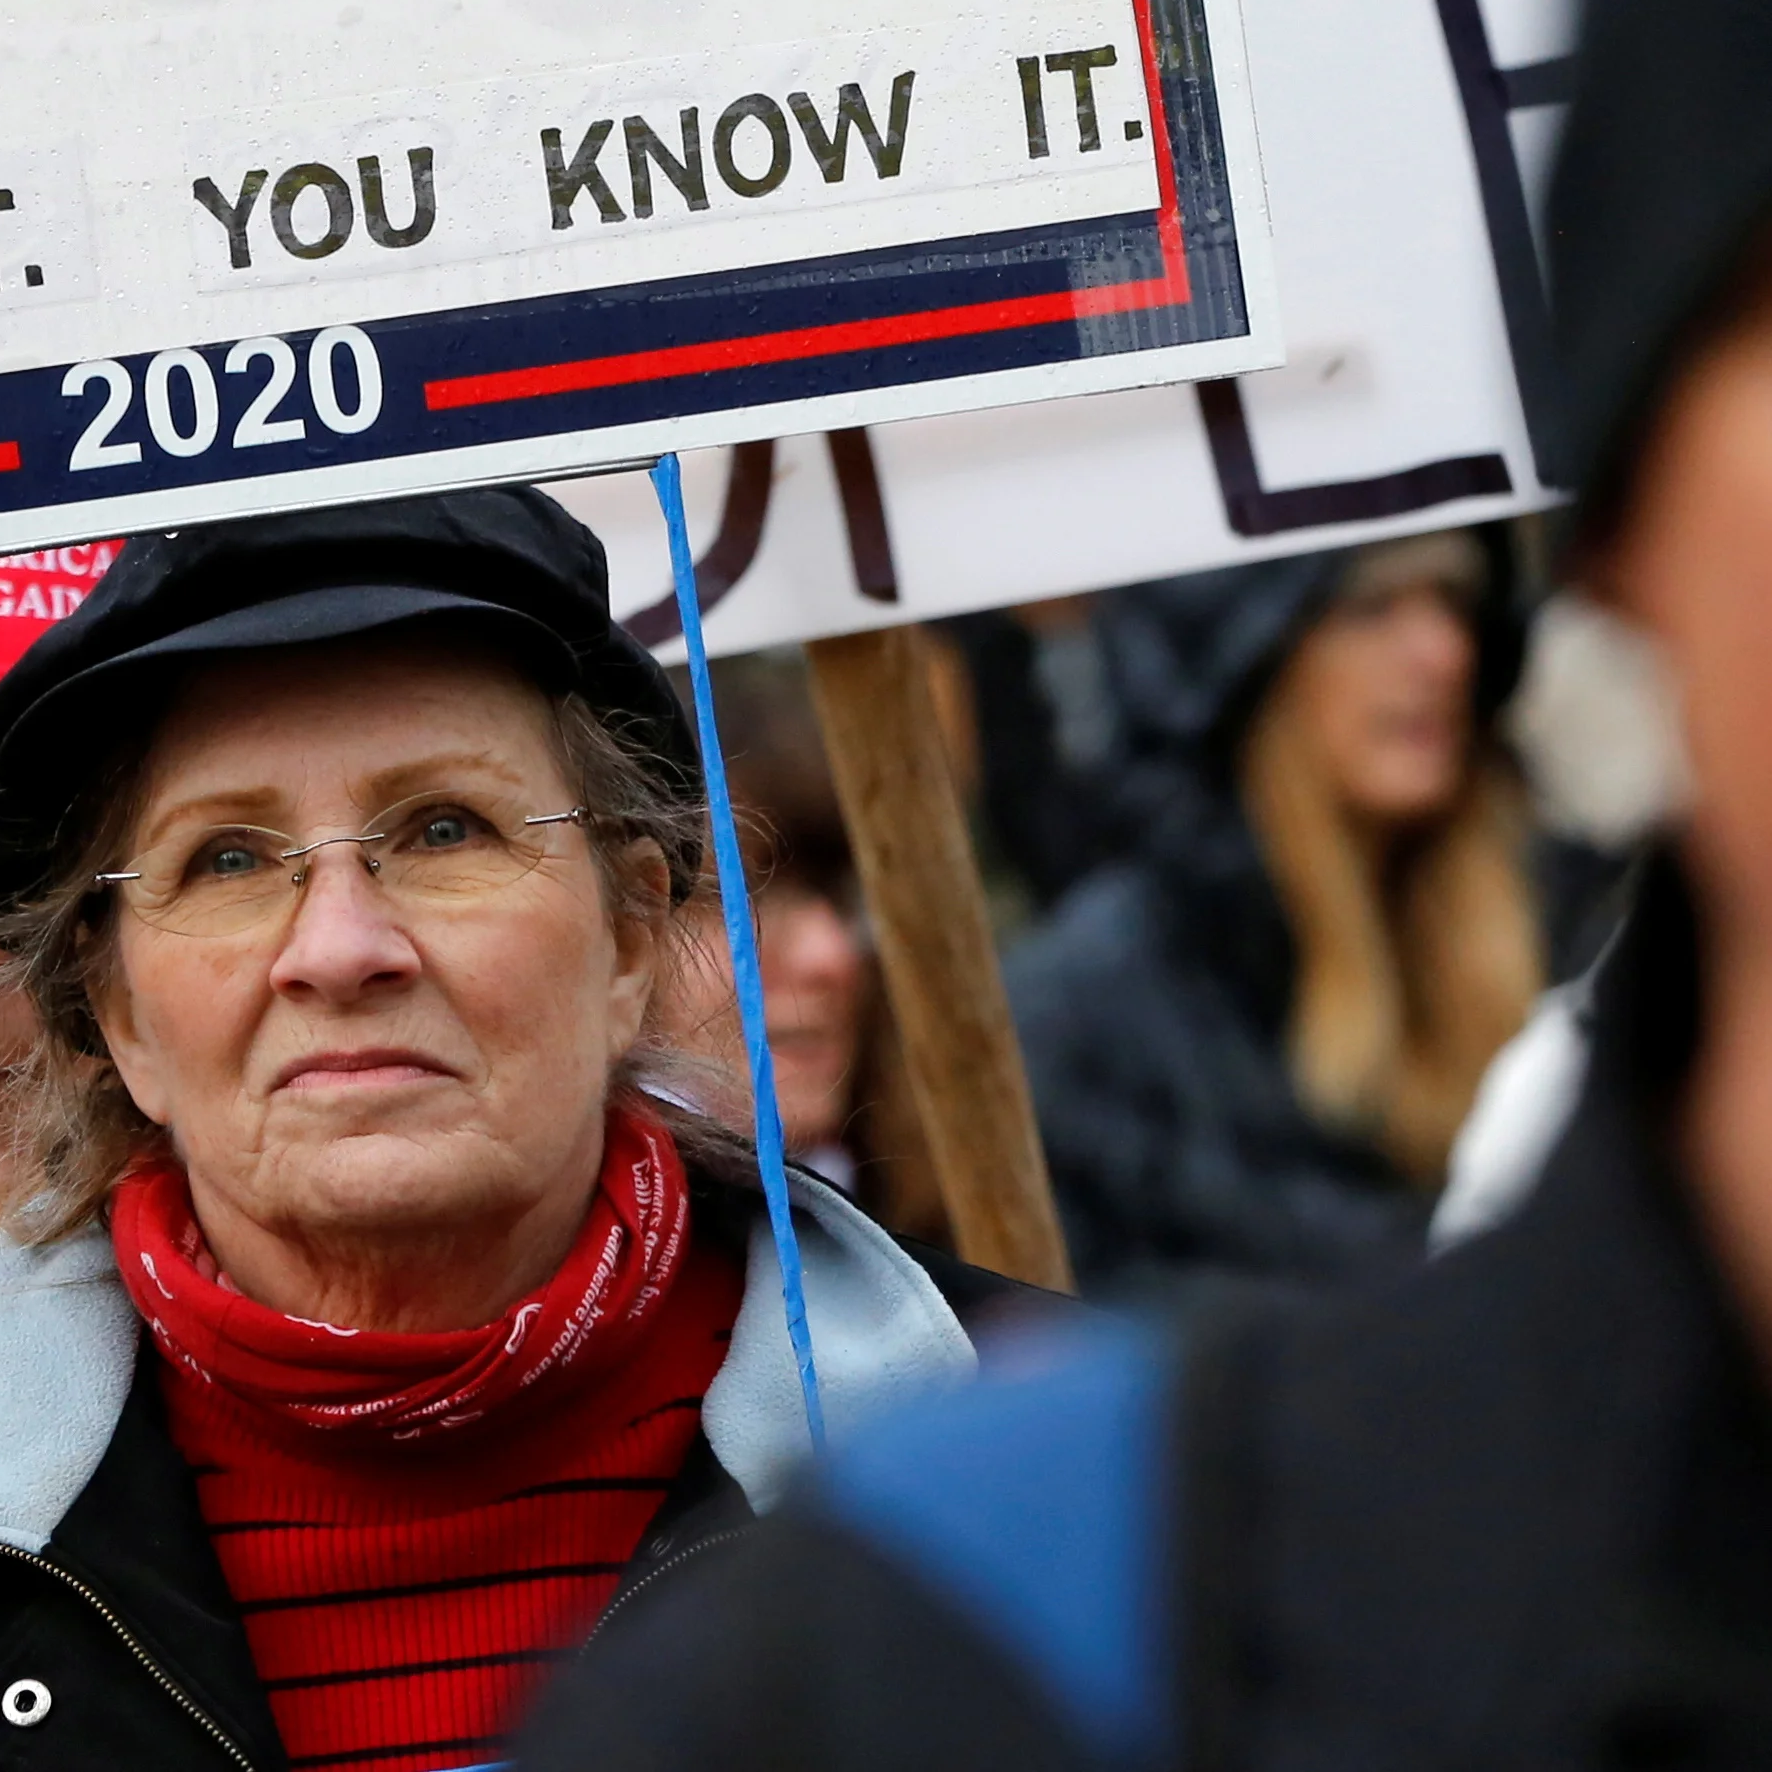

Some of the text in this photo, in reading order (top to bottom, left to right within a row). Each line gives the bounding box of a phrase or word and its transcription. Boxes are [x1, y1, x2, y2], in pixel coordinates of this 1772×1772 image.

[193, 147, 436, 270] YOU
[540, 70, 915, 230] KNOW
[1016, 43, 1145, 159] IT.
[60, 322, 383, 472] 2020
